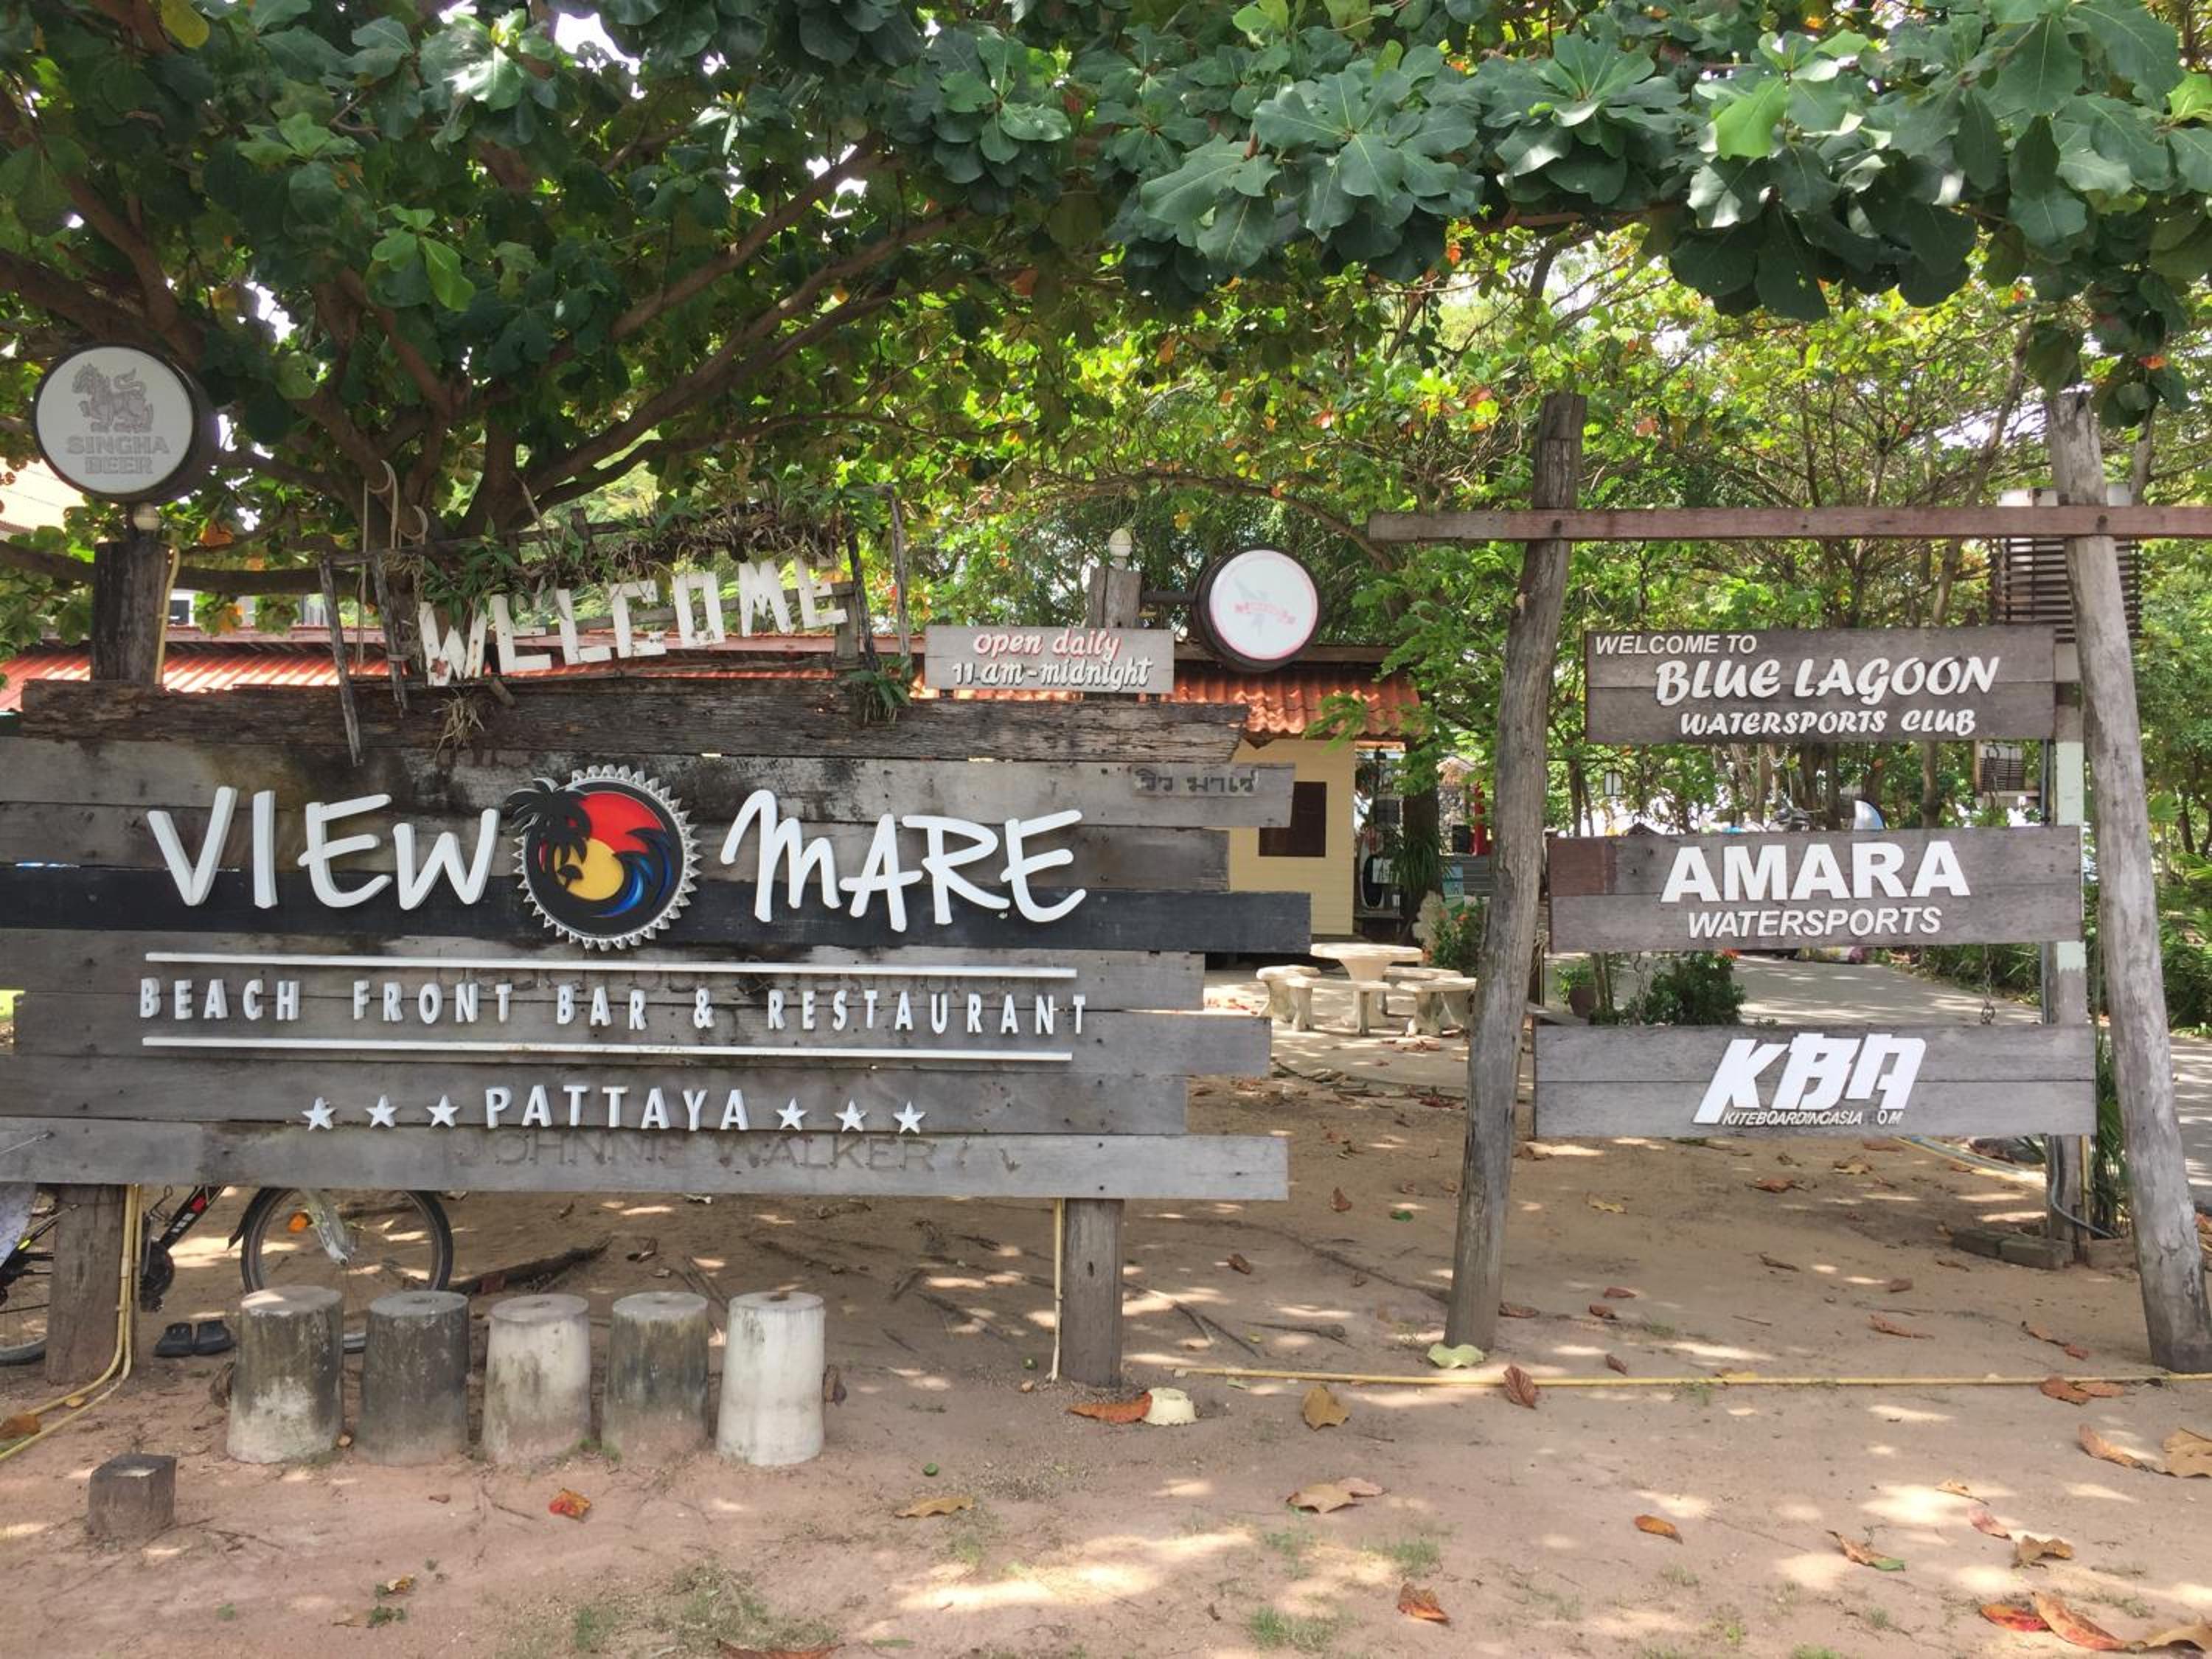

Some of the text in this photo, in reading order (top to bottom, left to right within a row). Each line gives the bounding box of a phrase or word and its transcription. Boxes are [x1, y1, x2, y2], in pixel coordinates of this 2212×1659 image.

[67, 436, 170, 454] SINGHA
[85, 456, 153, 474] BEER
[417, 554, 848, 686] WELCOME
[973, 628, 1122, 662] open daily
[1595, 635, 1758, 655] WELCOME TO
[1655, 655, 2001, 706] BLUE LAGOON
[1680, 709, 1977, 736] WATERSPORTS CLUB
[147, 786, 1087, 933] VIEW MARE
[1660, 840, 1972, 904] AMARA
[1687, 906, 1942, 939] WATERSPORTS
[139, 977, 301, 1020] BEACH
[352, 979, 512, 1023] FRONT
[557, 983, 649, 1031] BAR
[693, 987, 714, 1029] &
[767, 989, 1087, 1034] RESTAURANT
[1693, 1032, 1927, 1122] KBA
[484, 1085, 751, 1131] PATTAYA
